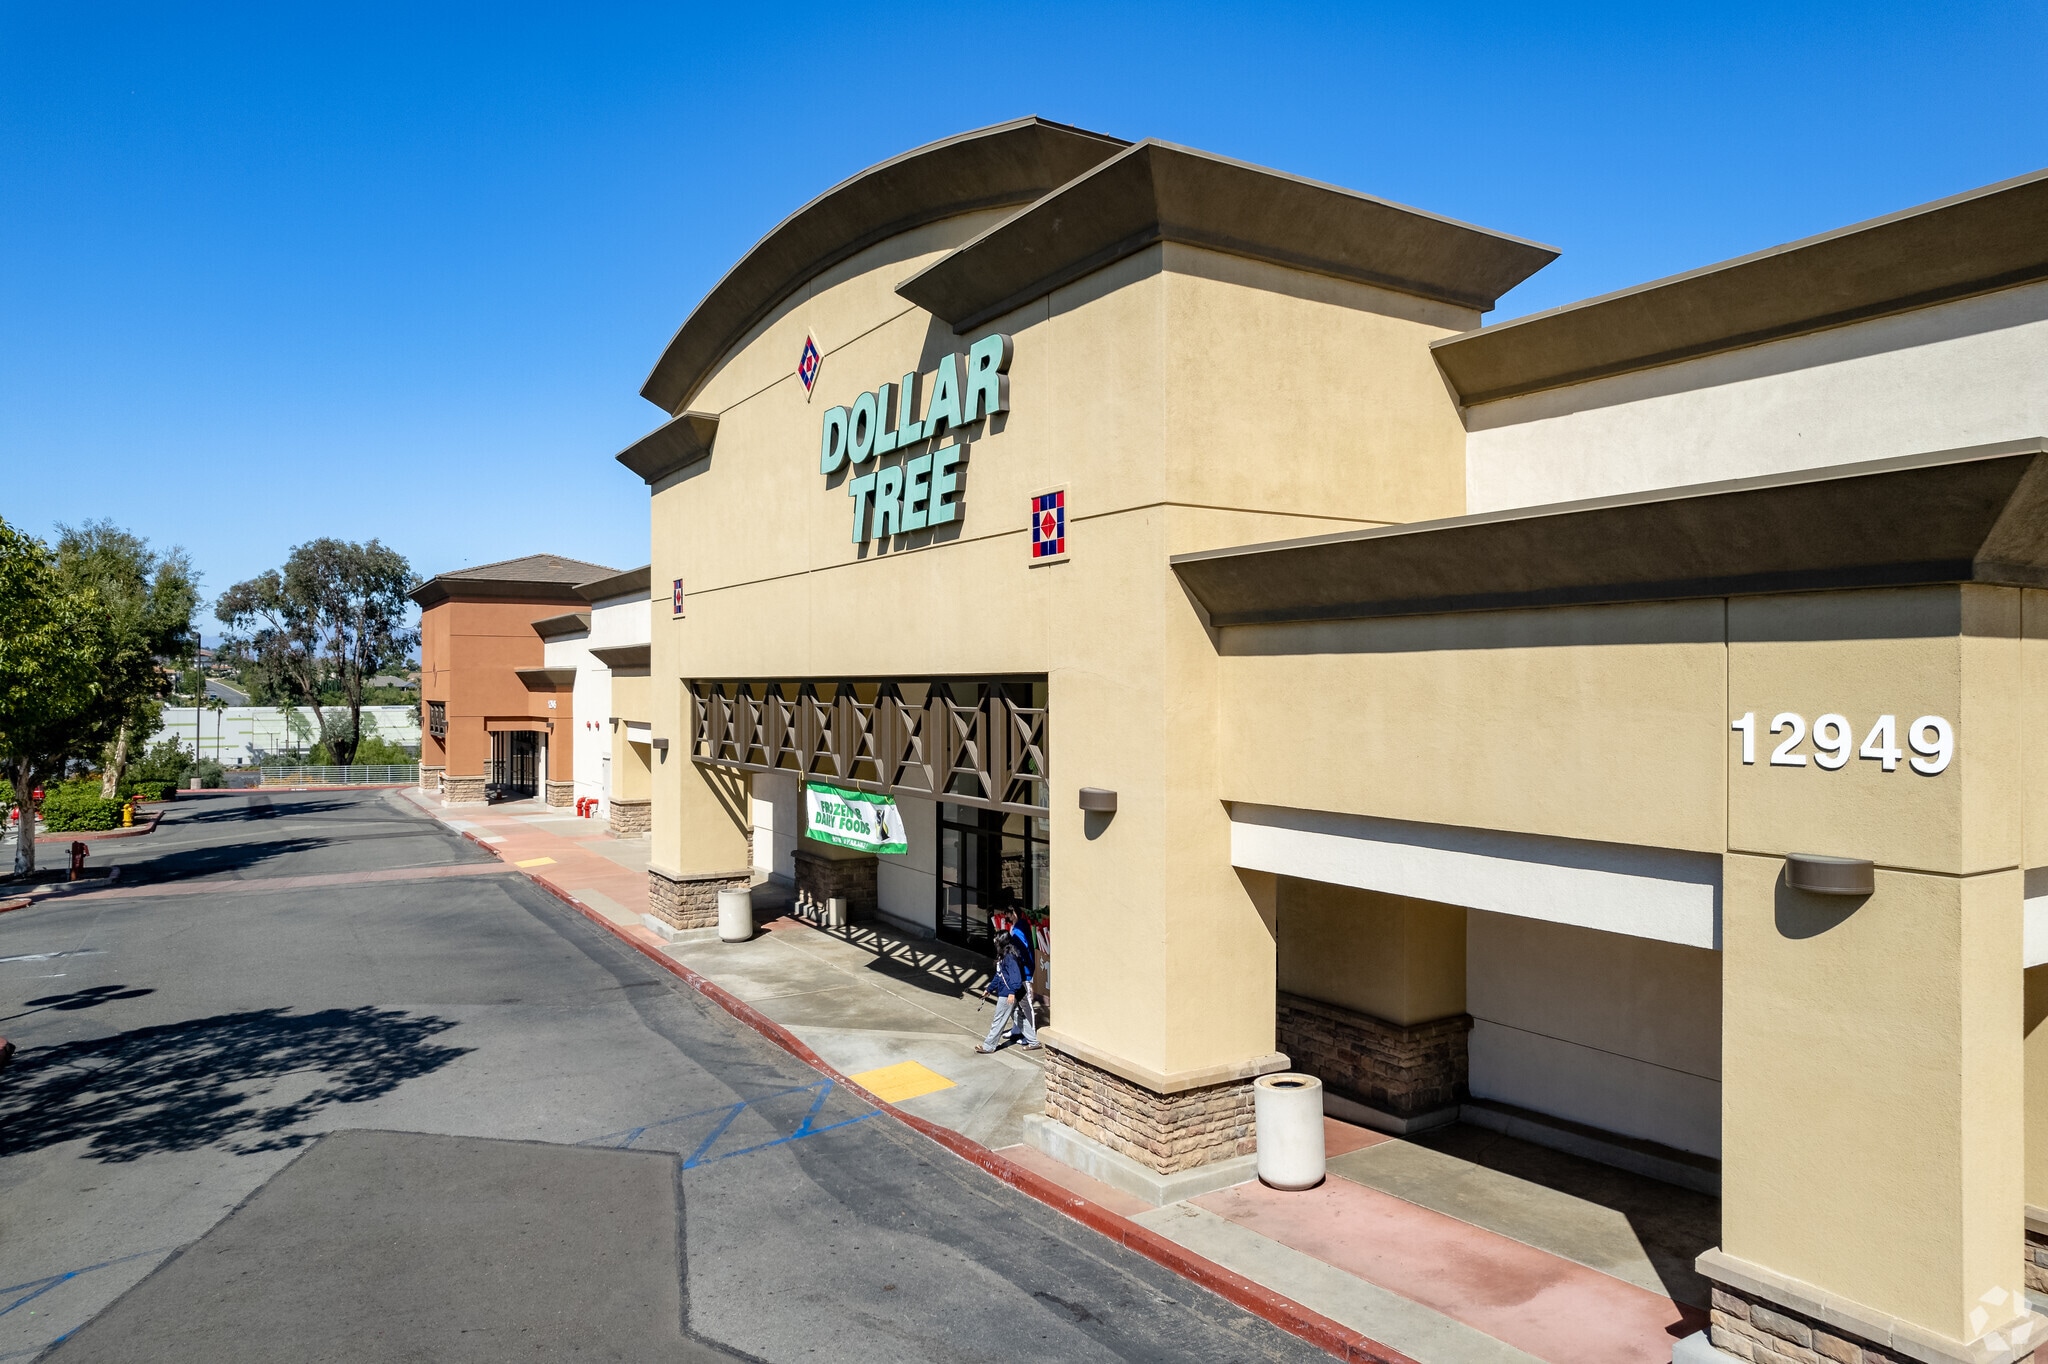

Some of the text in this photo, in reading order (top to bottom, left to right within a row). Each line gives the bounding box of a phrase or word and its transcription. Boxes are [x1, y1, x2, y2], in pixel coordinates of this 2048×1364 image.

[820, 333, 1012, 475] DOLLAR
[848, 443, 969, 543] TREE
[1731, 712, 1955, 776] 12949
[820, 800, 854, 818] FROZEN
[839, 818, 871, 835] FOODS
